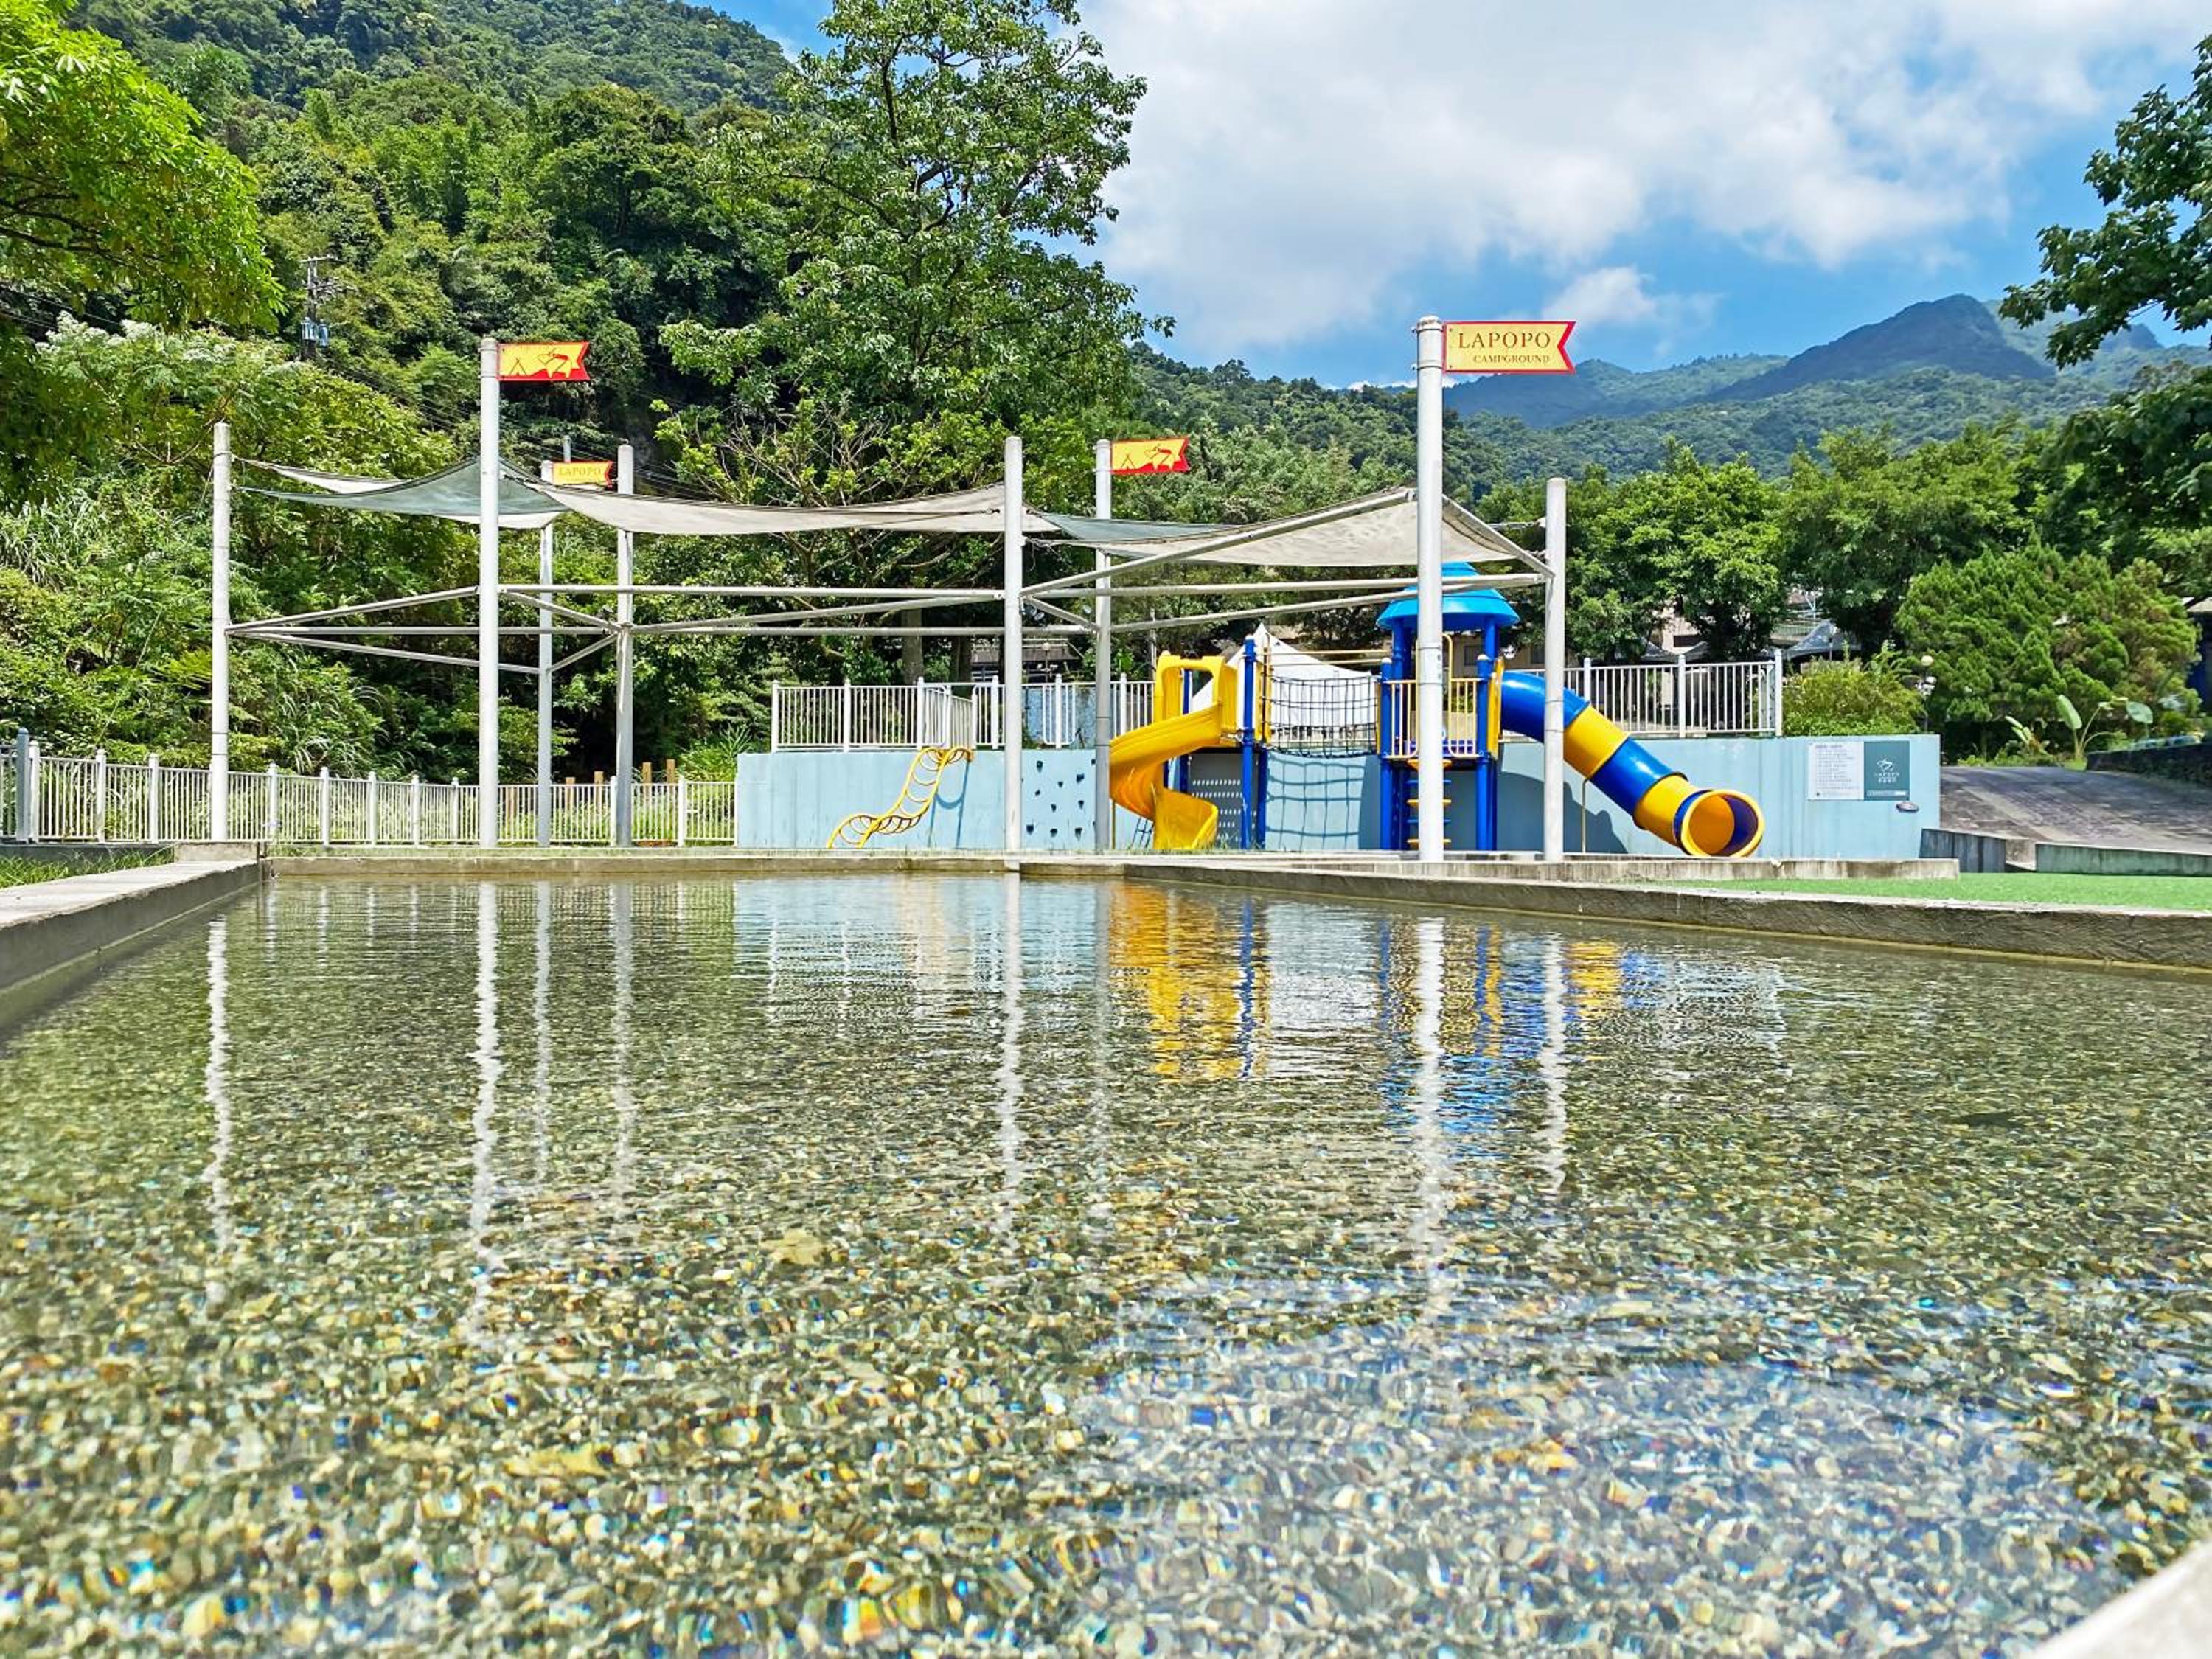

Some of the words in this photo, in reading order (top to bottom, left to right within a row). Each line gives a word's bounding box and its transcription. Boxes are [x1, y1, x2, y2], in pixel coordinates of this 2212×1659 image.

[1458, 332, 1550, 349] LAPOPO
[1474, 355, 1550, 364] CAMPGROUND
[559, 467, 601, 476] LAPOPO
